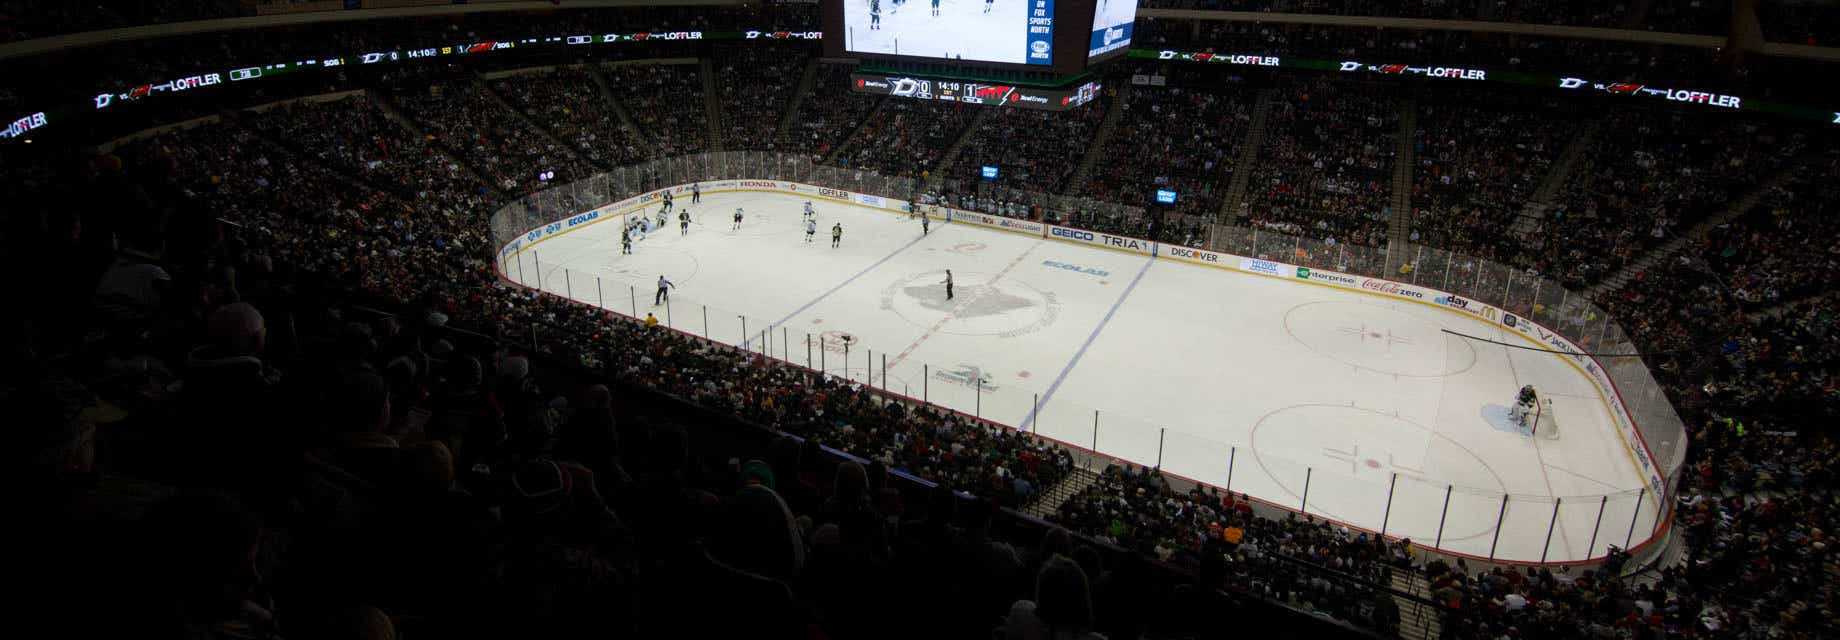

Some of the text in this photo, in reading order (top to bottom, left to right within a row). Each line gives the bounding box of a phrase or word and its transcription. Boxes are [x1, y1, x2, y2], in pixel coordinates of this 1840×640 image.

[664, 31, 702, 39] LOFFLER
[408, 50, 430, 58] 14:10
[1230, 54, 1280, 66] LOFFLER
[1426, 66, 1486, 80] LOFFLER
[169, 73, 221, 92] LOFFLER
[937, 81, 960, 91] 14:10
[1666, 88, 1740, 108] LOFFLER
[8, 112, 47, 138] LOFFLER
[740, 181, 777, 189] HONDA
[818, 188, 849, 200] LOFFLER
[568, 211, 599, 227] ECOLAB
[1052, 227, 1094, 242] GEICO
[1102, 234, 1140, 251] TRIA
[1171, 247, 1218, 264] DISCOVER
[1042, 260, 1110, 277] ECOLAB
[1400, 288, 1423, 299] zero
